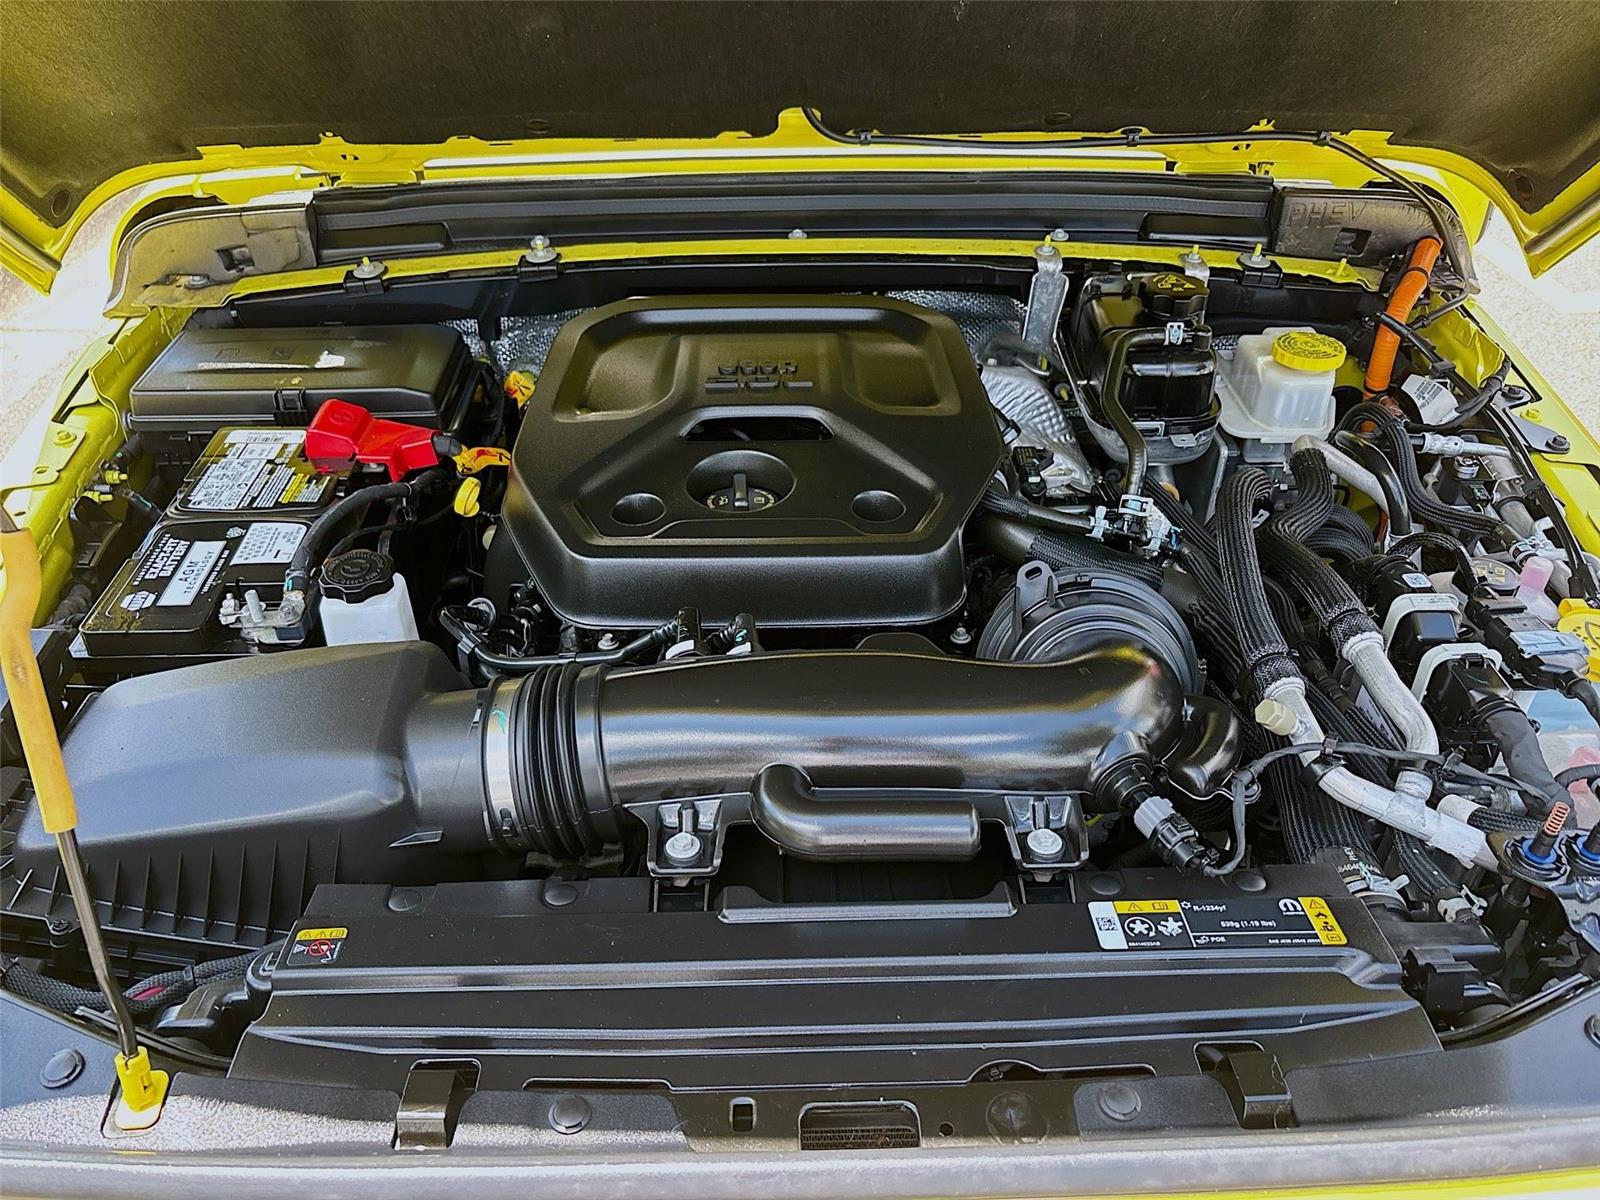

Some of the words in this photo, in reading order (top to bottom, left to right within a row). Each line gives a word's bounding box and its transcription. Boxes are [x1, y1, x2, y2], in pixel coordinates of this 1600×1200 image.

[1286, 201, 1368, 228] PHEV
[143, 537, 180, 580] EXACT-FIT
[158, 539, 191, 577] BATTERY
[179, 560, 201, 582] AGM
[183, 550, 215, 595] TECHNOLOGY
